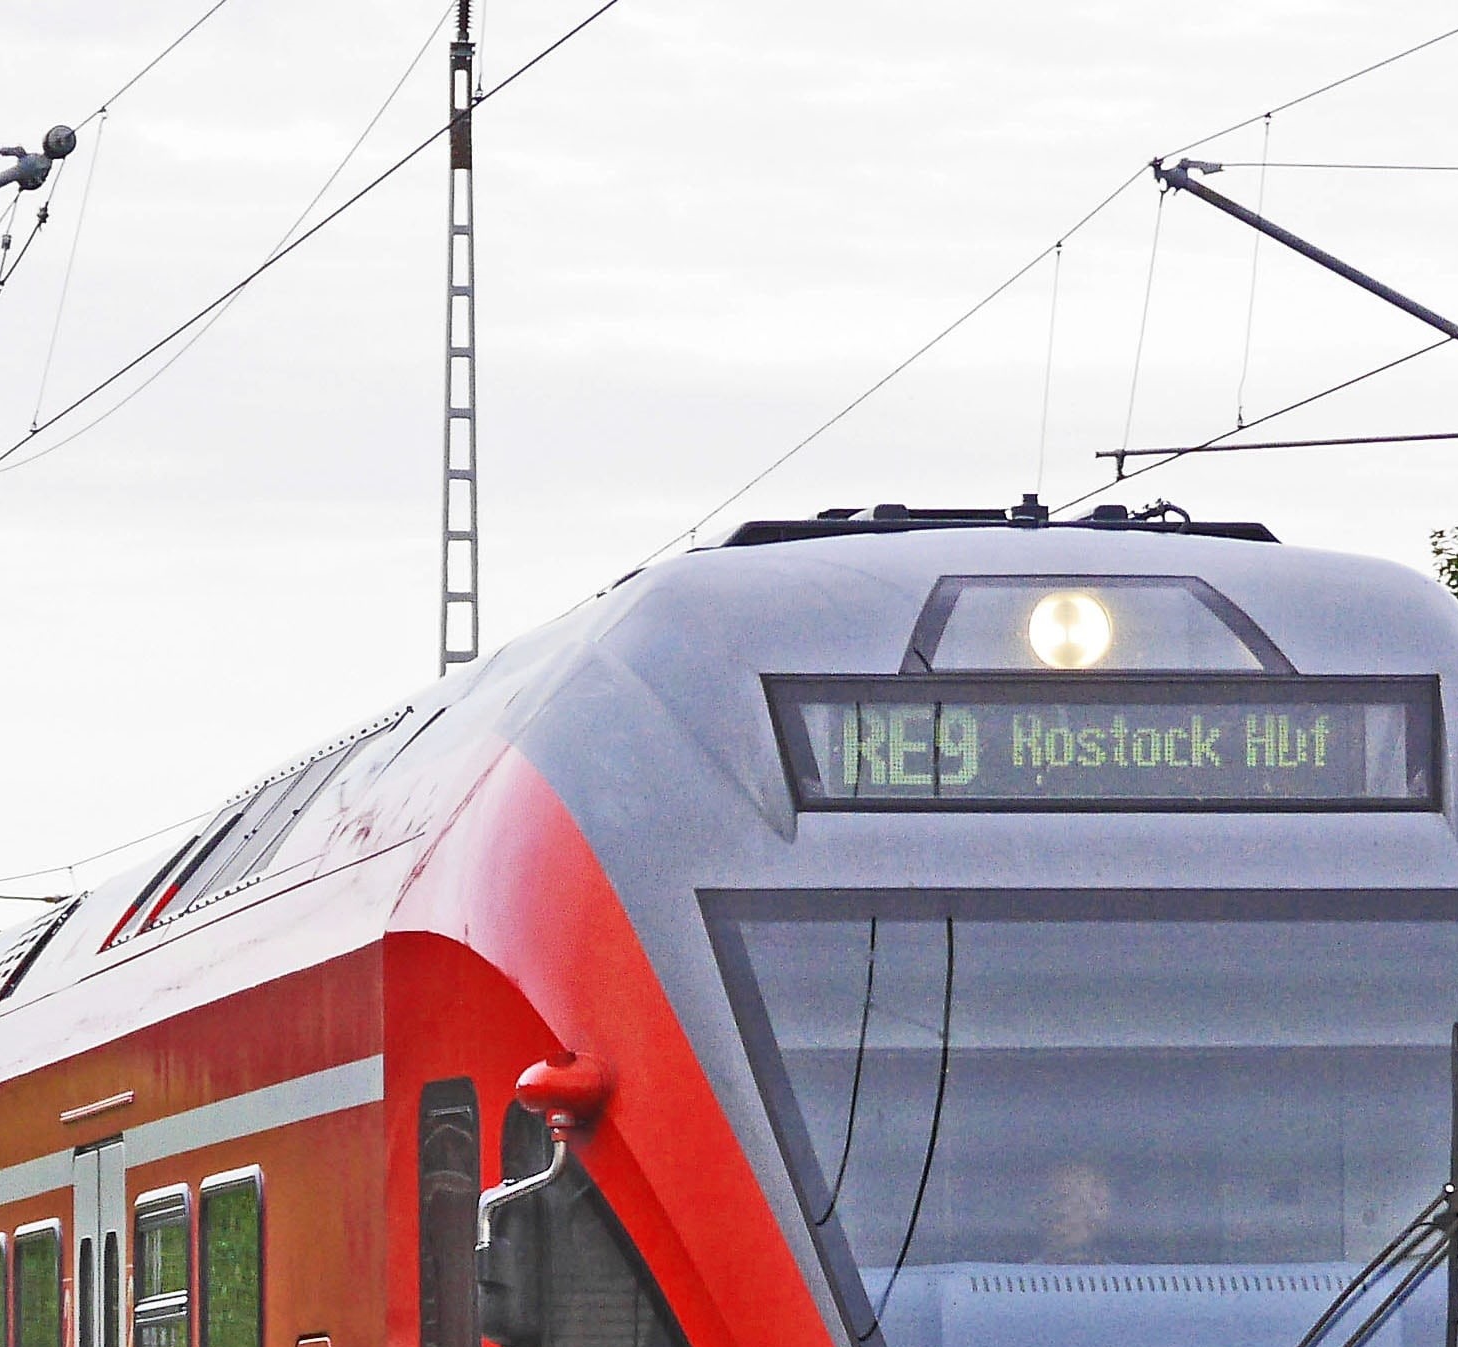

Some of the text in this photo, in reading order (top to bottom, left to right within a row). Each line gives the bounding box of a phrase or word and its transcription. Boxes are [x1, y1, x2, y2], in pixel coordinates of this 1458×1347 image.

[843, 709, 977, 785] RE9
[1013, 714, 1329, 768] Rostock Hbf
